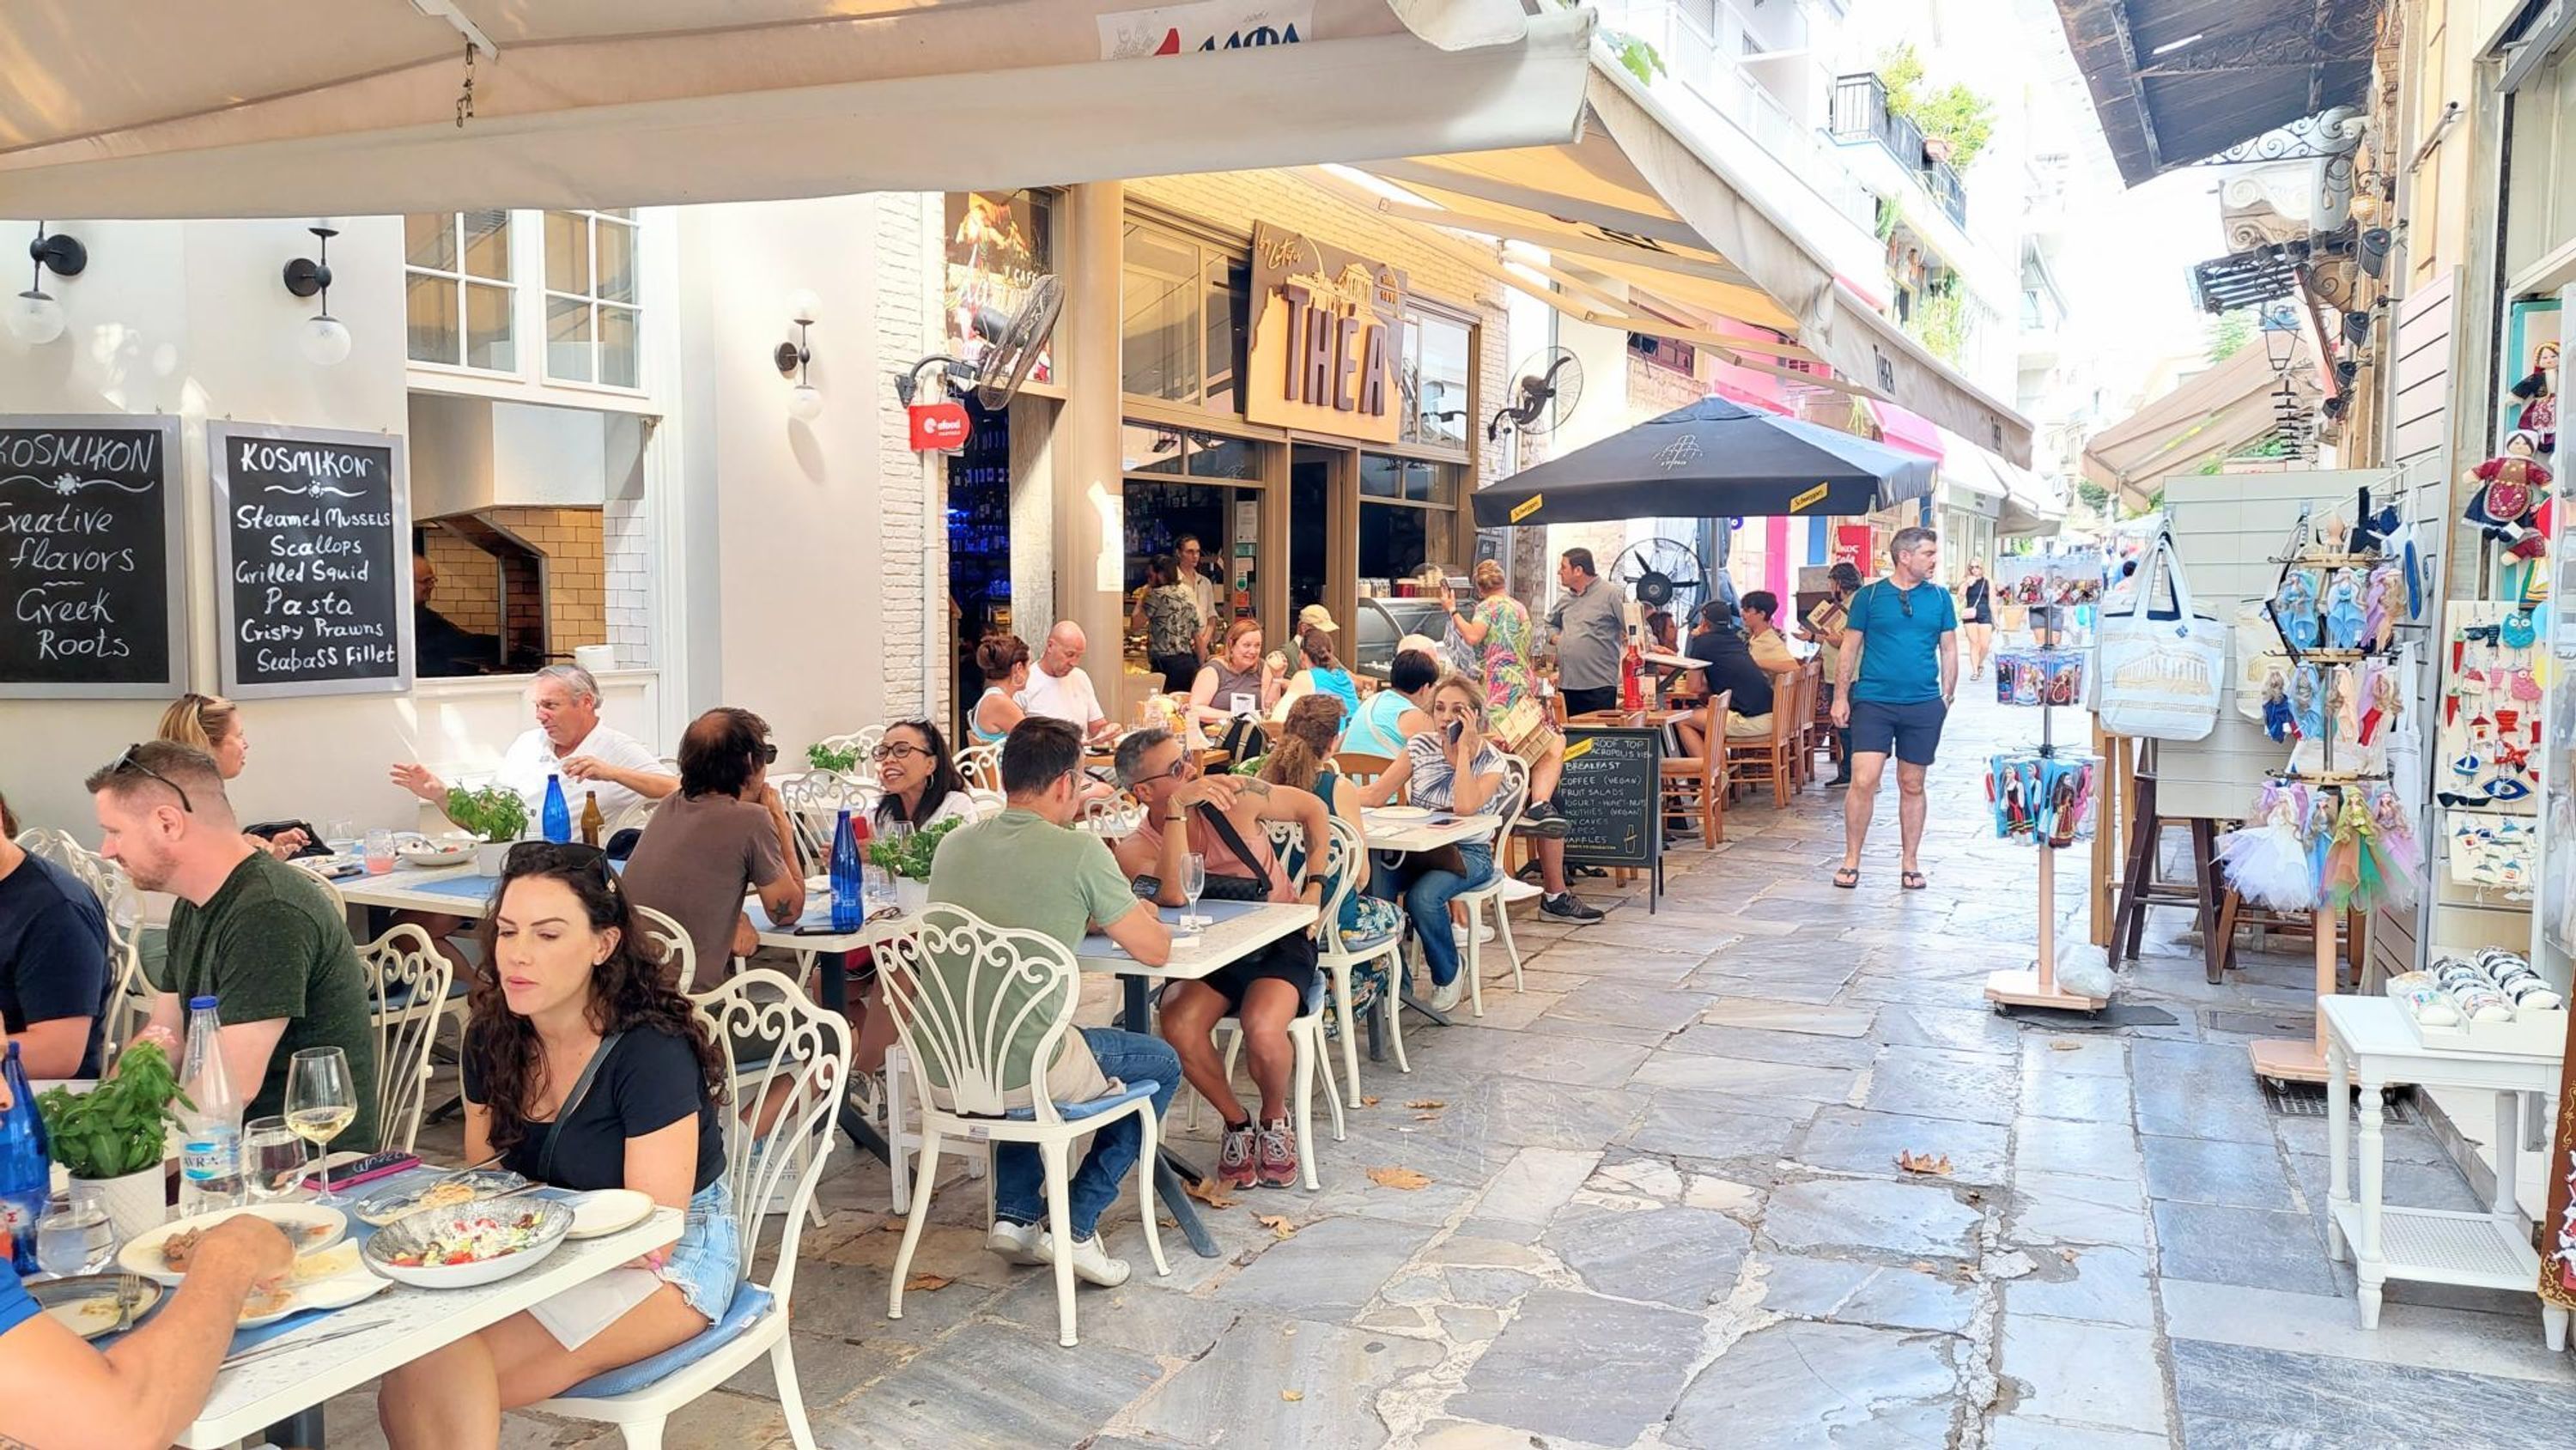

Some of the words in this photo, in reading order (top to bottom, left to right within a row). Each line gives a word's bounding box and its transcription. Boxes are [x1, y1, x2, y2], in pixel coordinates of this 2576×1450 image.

[1281, 283, 1388, 416] THEA
[240, 442, 374, 478] KOSMIKON
[236, 505, 320, 530] Steamed
[9, 537, 136, 573] flavors
[270, 535, 362, 561] Scallops
[236, 559, 304, 584] Grilled
[313, 560, 369, 582] Squid
[15, 588, 115, 624] Greek
[264, 587, 355, 616] Pasta
[241, 619, 303, 643] Crispy
[315, 618, 384, 638] Prawns
[36, 628, 131, 660] Roots
[346, 646, 397, 666] Fillet
[1590, 748, 1634, 757] ACROPOLIS
[1625, 740, 1644, 749] TOP
[1565, 760, 1622, 772] BREAKFAST
[1561, 775, 1596, 786] COFFEE
[1589, 787, 1624, 797] SALADS
